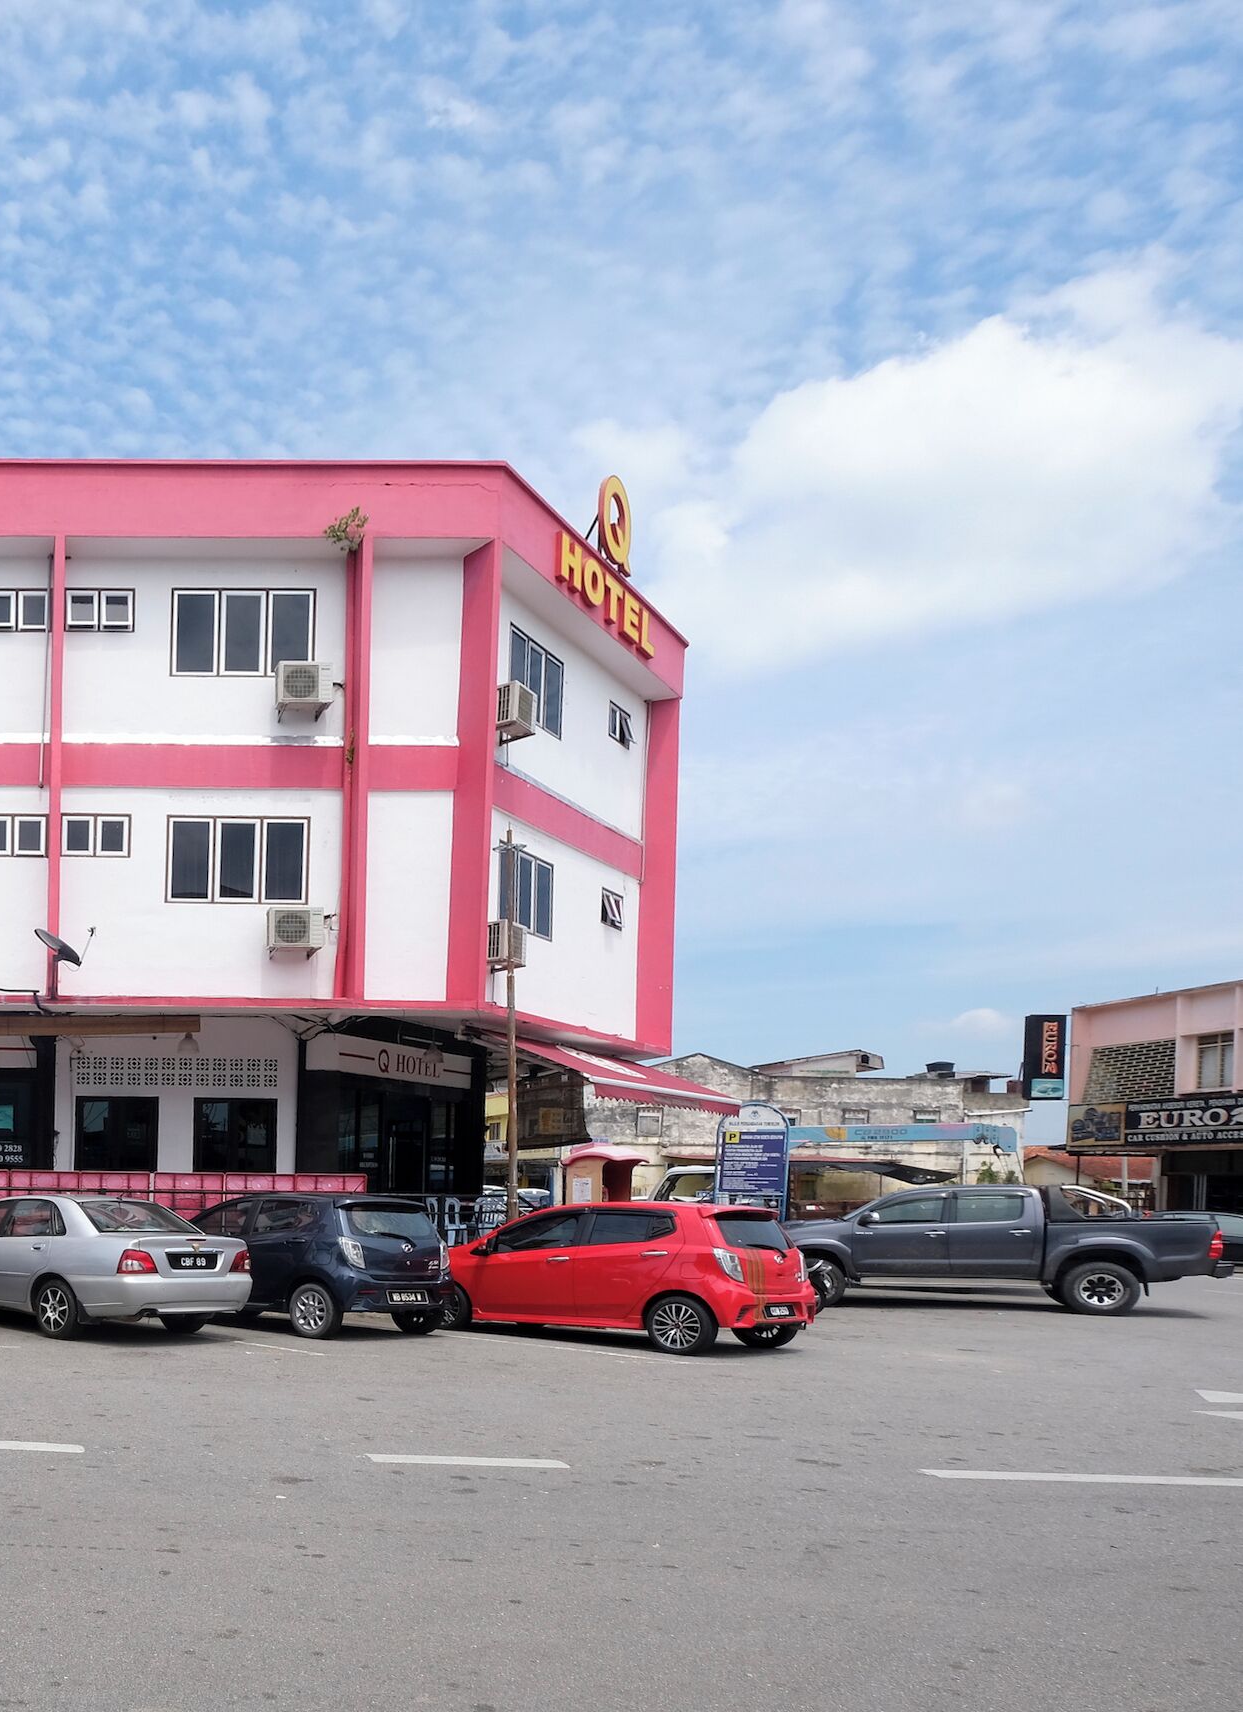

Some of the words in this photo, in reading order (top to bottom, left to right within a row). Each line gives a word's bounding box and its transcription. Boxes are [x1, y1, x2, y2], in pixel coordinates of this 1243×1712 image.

[599, 475, 631, 577] Q
[555, 530, 655, 660] HOTEL
[378, 1049, 390, 1073] Q
[396, 1054, 440, 1078] HOTEL
[729, 1133, 737, 1142] P
[1127, 1134, 1144, 1142] CAR
[1145, 1133, 1180, 1141] CUSHION
[1181, 1132, 1189, 1140] &
[1190, 1131, 1214, 1140] AUTO
[4, 1144, 23, 1153] 2828
[4, 1154, 24, 1163] 9555
[180, 1256, 195, 1267] CBF
[195, 1256, 207, 1267] 89
